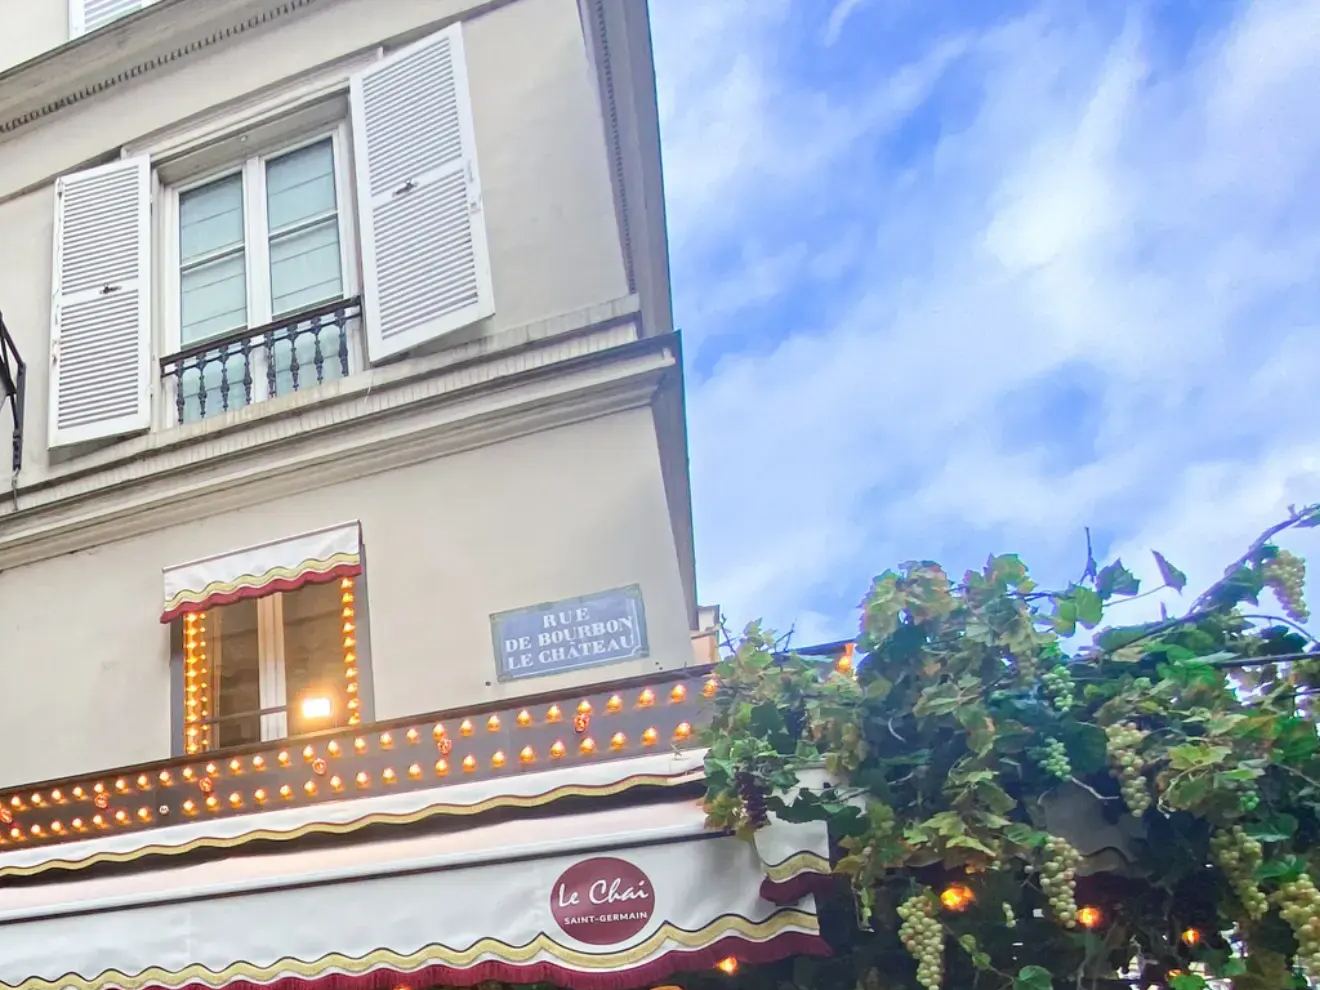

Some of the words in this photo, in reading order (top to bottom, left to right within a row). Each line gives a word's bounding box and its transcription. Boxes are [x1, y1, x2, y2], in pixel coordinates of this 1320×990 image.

[543, 607, 589, 628] RUE
[505, 636, 532, 653] DE
[538, 615, 633, 646] BOURBON
[507, 653, 534, 670] LE
[538, 635, 634, 664] CHÂTEAU
[558, 883, 580, 908] Le
[589, 878, 649, 904] Chai
[564, 911, 648, 925] SAINT-GERMAIN
